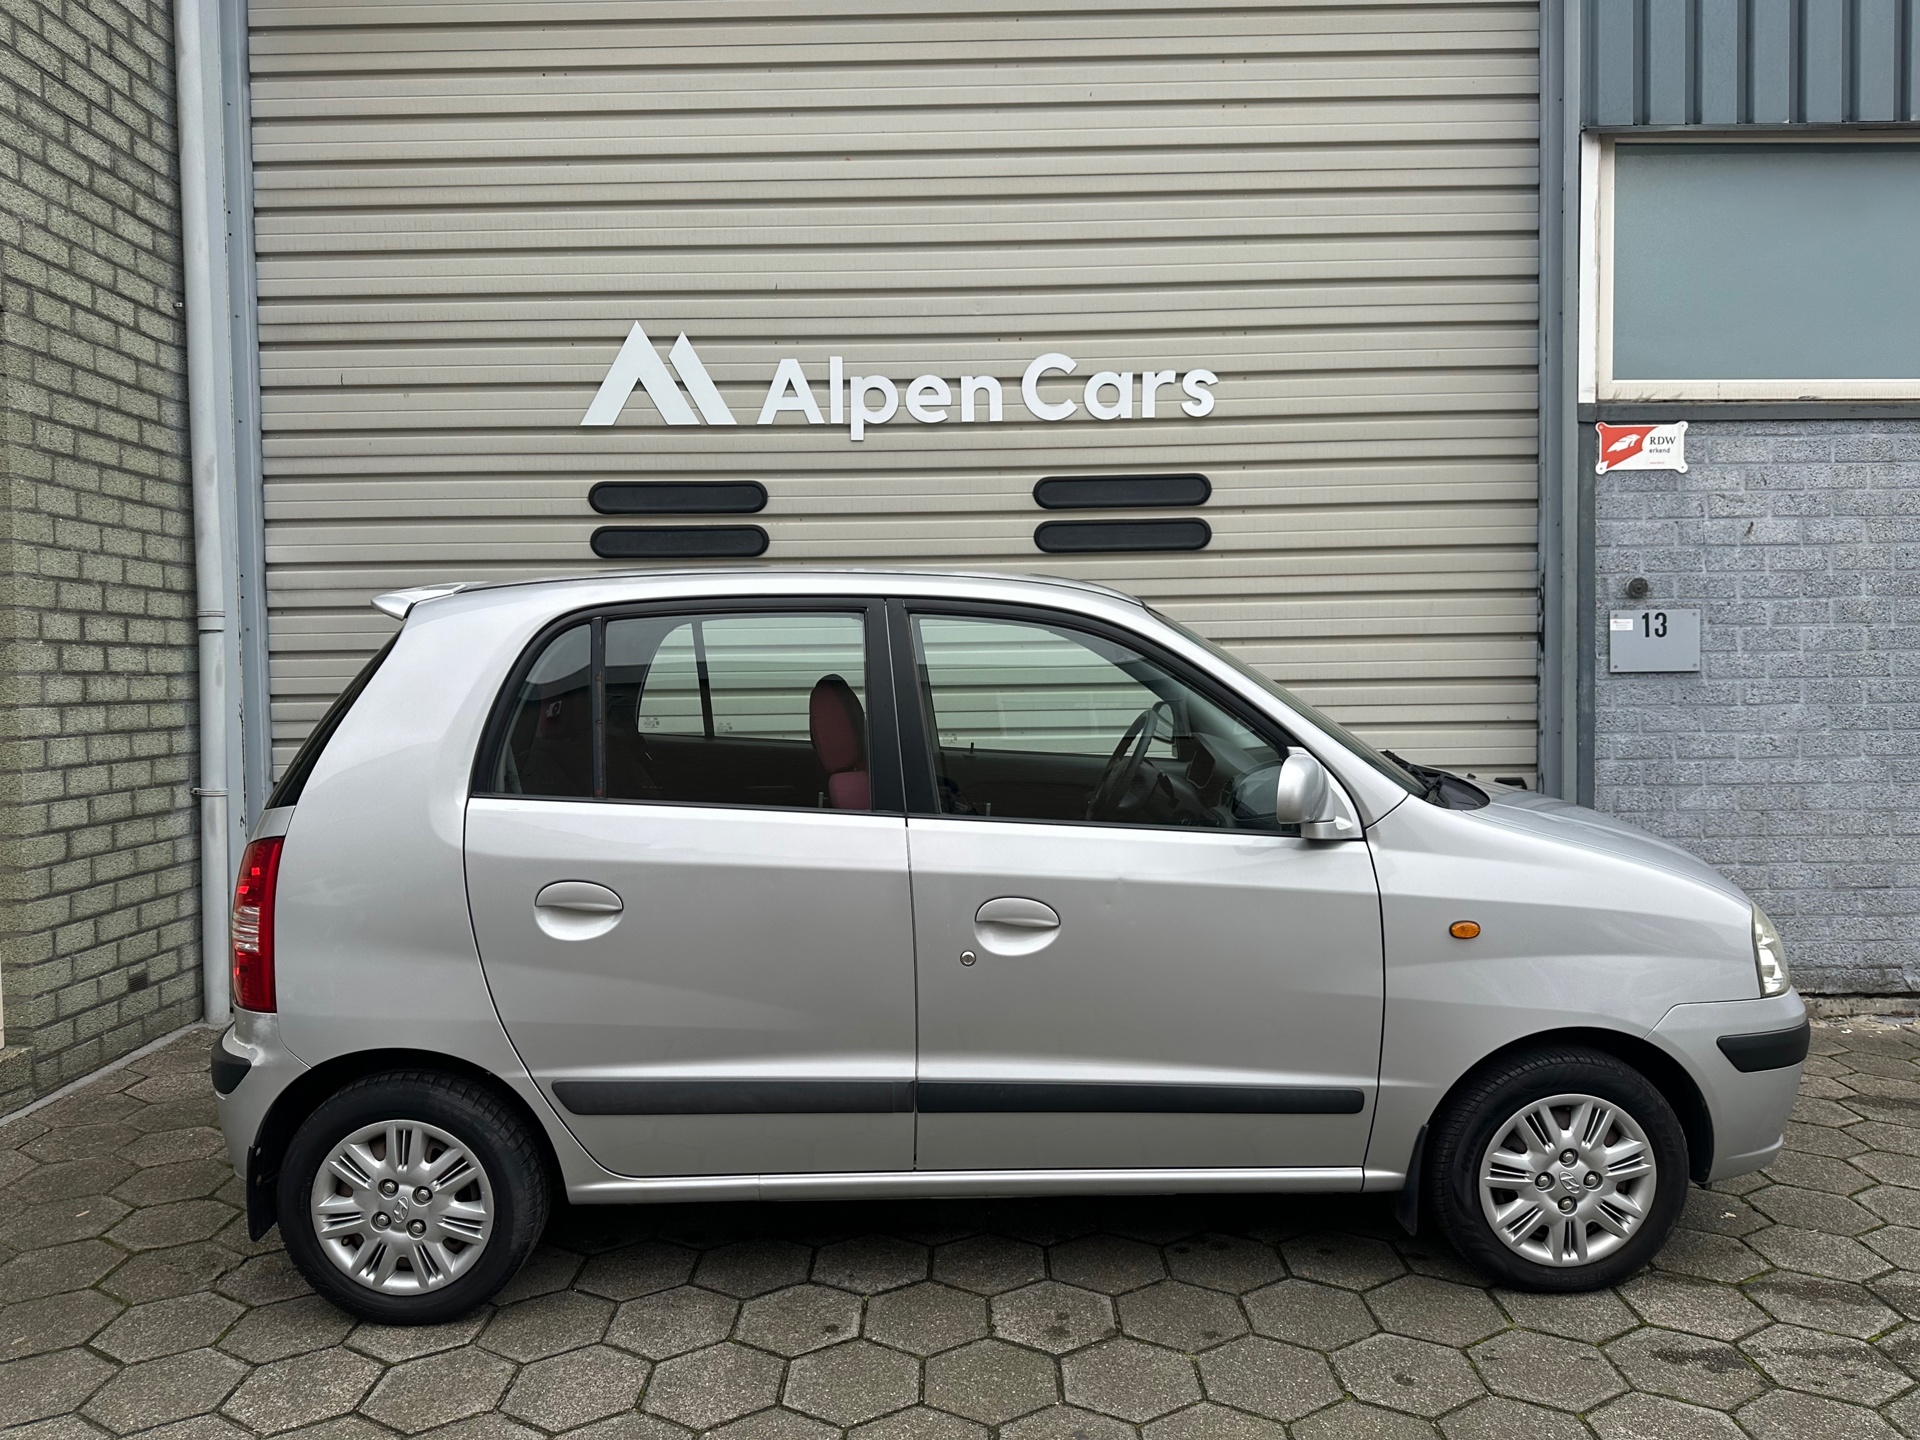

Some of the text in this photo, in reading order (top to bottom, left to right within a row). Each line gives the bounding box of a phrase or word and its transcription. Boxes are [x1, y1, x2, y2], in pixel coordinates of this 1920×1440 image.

[756, 352, 1219, 441] Alpen Cars
[1649, 436, 1676, 445] RDW
[1641, 612, 1667, 638] 13
